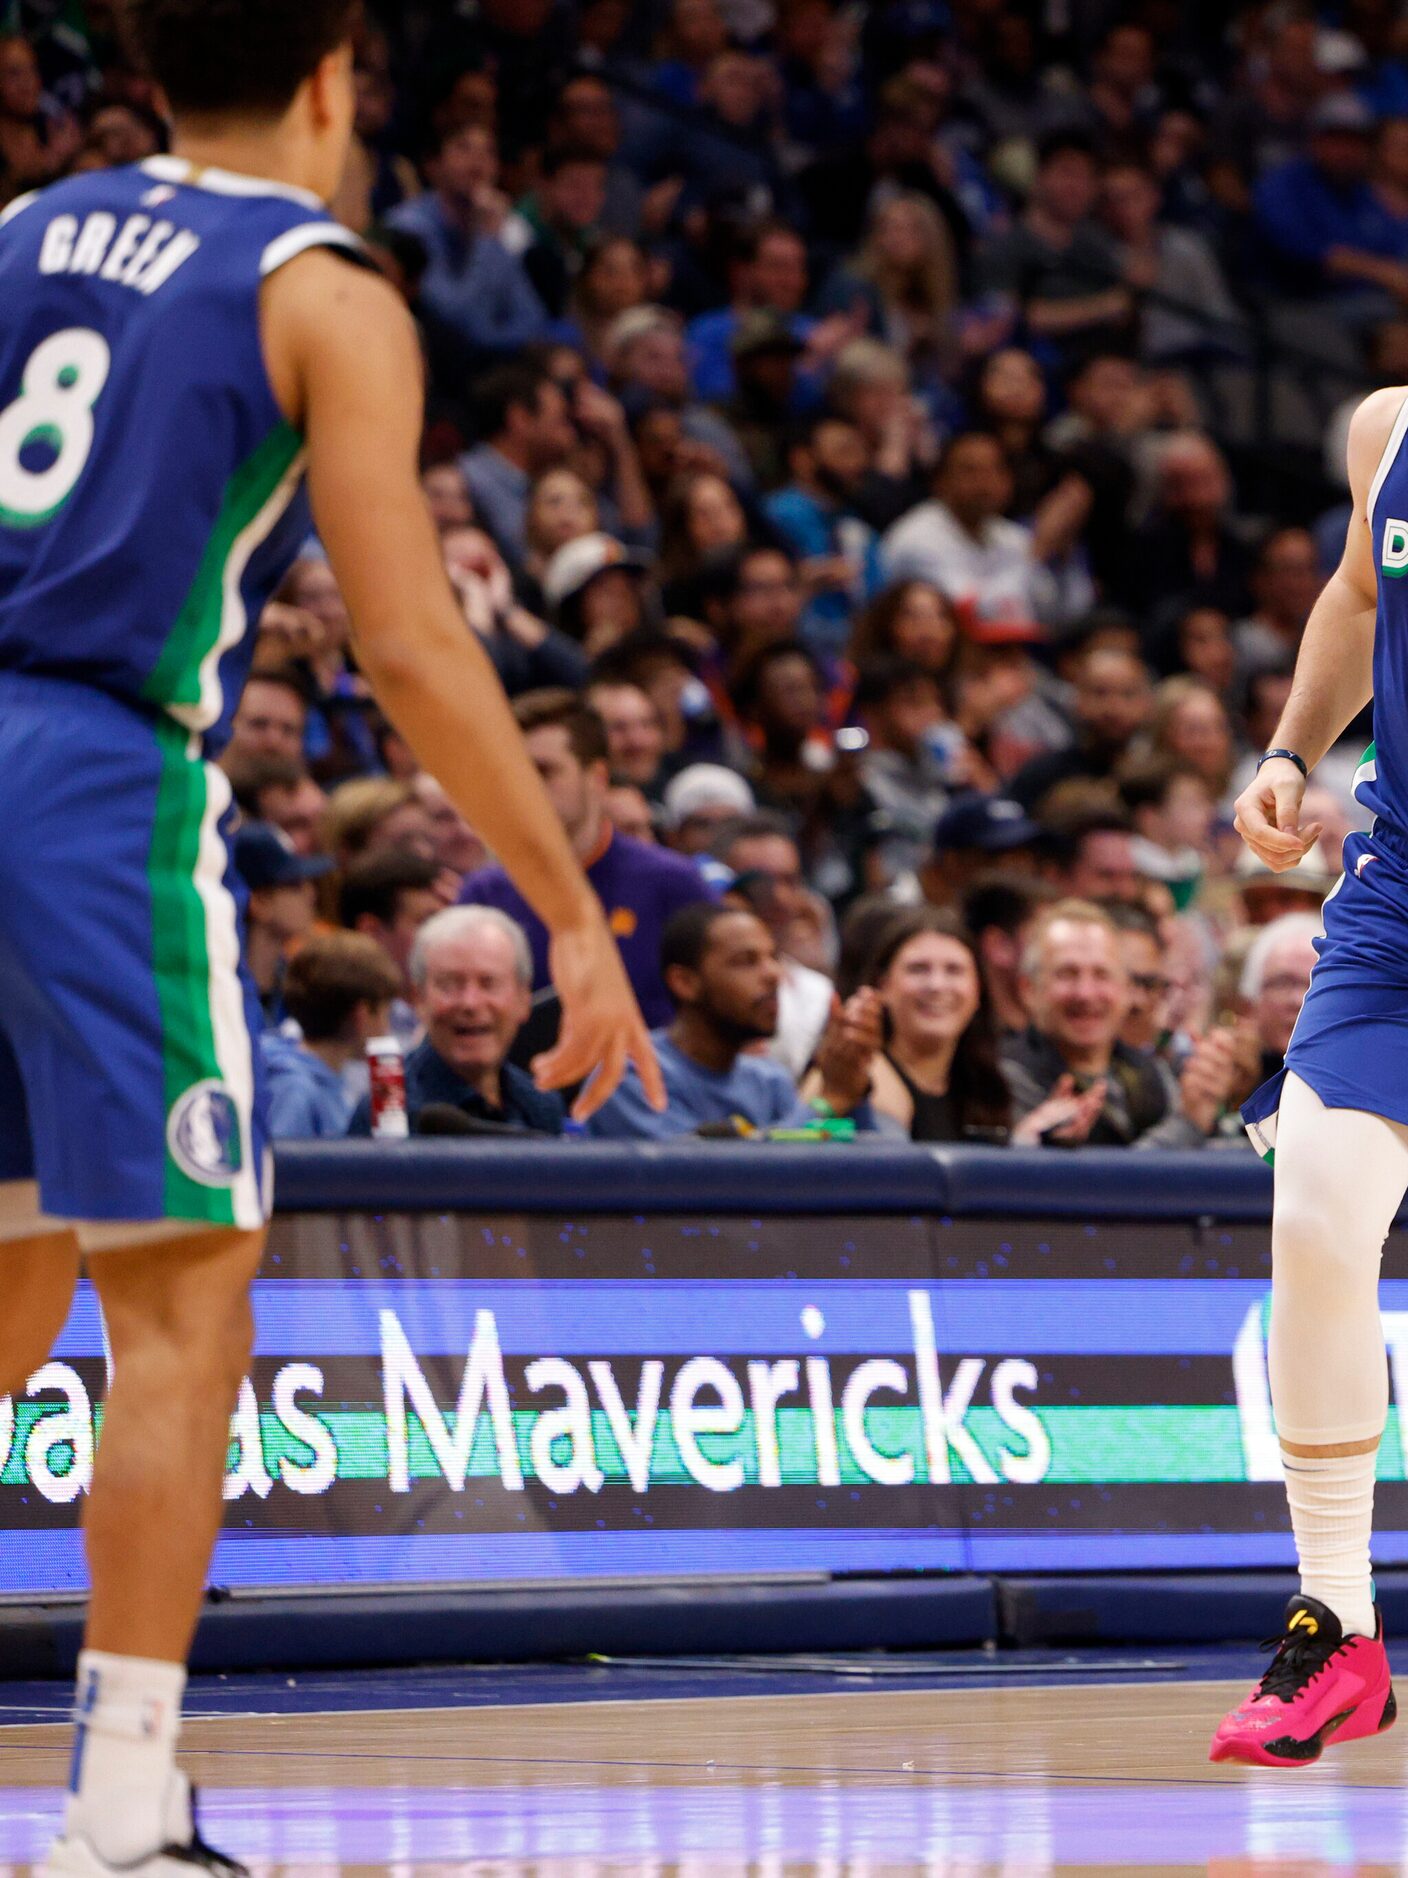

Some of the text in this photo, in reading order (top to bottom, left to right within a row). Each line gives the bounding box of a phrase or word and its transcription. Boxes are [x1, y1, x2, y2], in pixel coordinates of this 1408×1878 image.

[38, 211, 200, 296] GREEN
[0, 325, 111, 532] 8
[378, 1289, 1052, 1494] Mavericks
